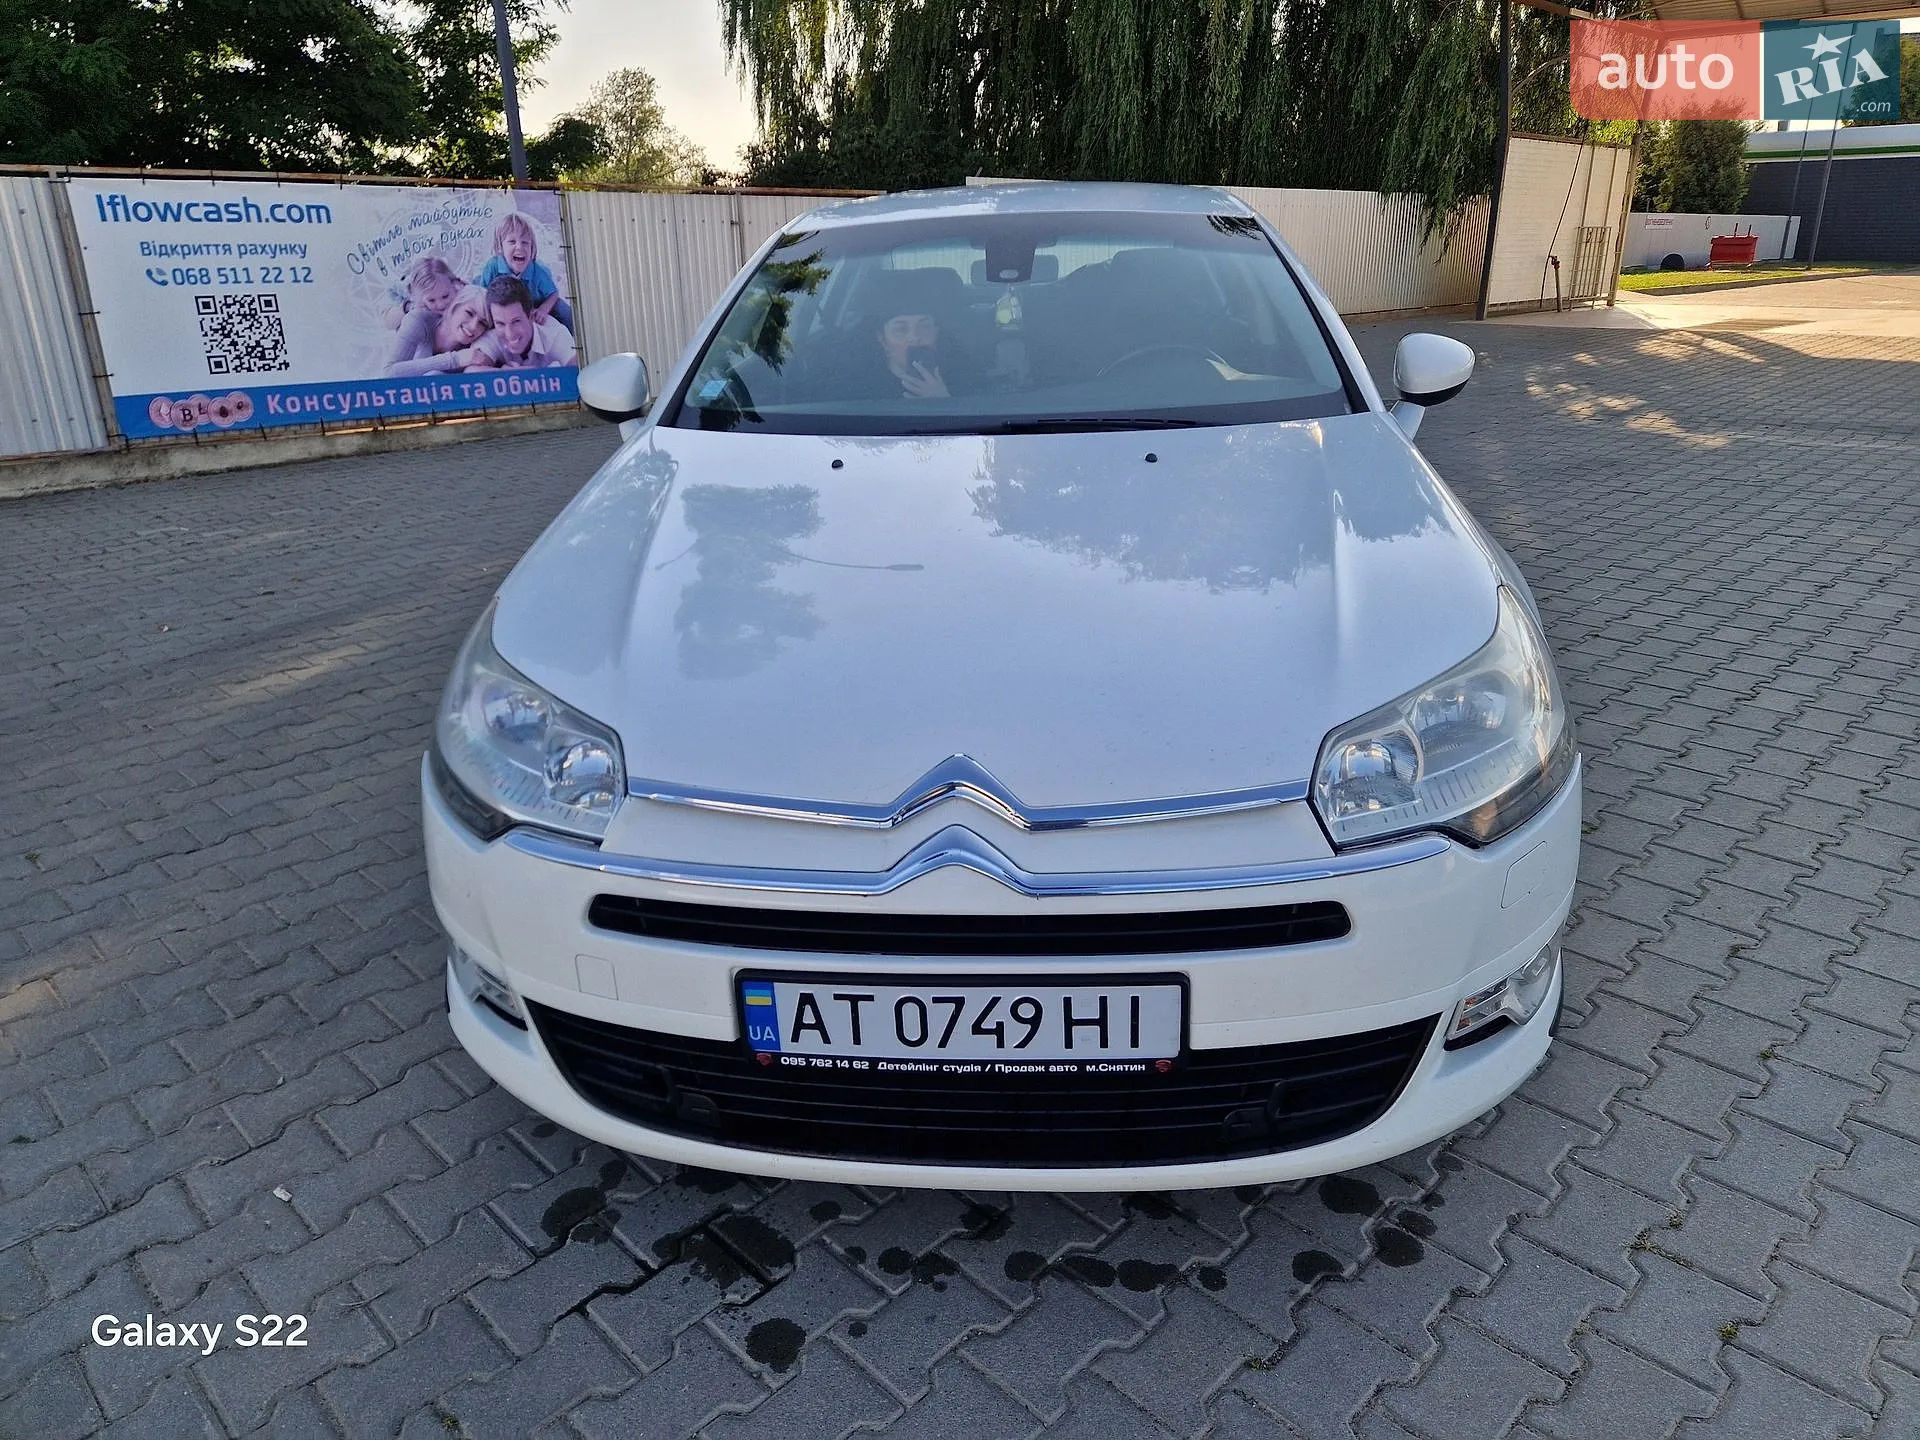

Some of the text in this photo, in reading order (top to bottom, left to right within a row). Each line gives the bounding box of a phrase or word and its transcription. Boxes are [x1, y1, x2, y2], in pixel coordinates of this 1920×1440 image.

[139, 240, 307, 260] Відкриття рахунку
[346, 223, 403, 275] Світле
[376, 226, 485, 277] в твоїх руках
[172, 266, 313, 286] 068 511 22 12
[266, 374, 561, 415] Консультація та Обмін
[749, 1025, 777, 1042] UA
[790, 992, 1141, 1050] AT 0749 HI
[780, 1056, 1146, 1074] 095 762 14 62 Детейлінг студія / Продаж авто м.Снятин
